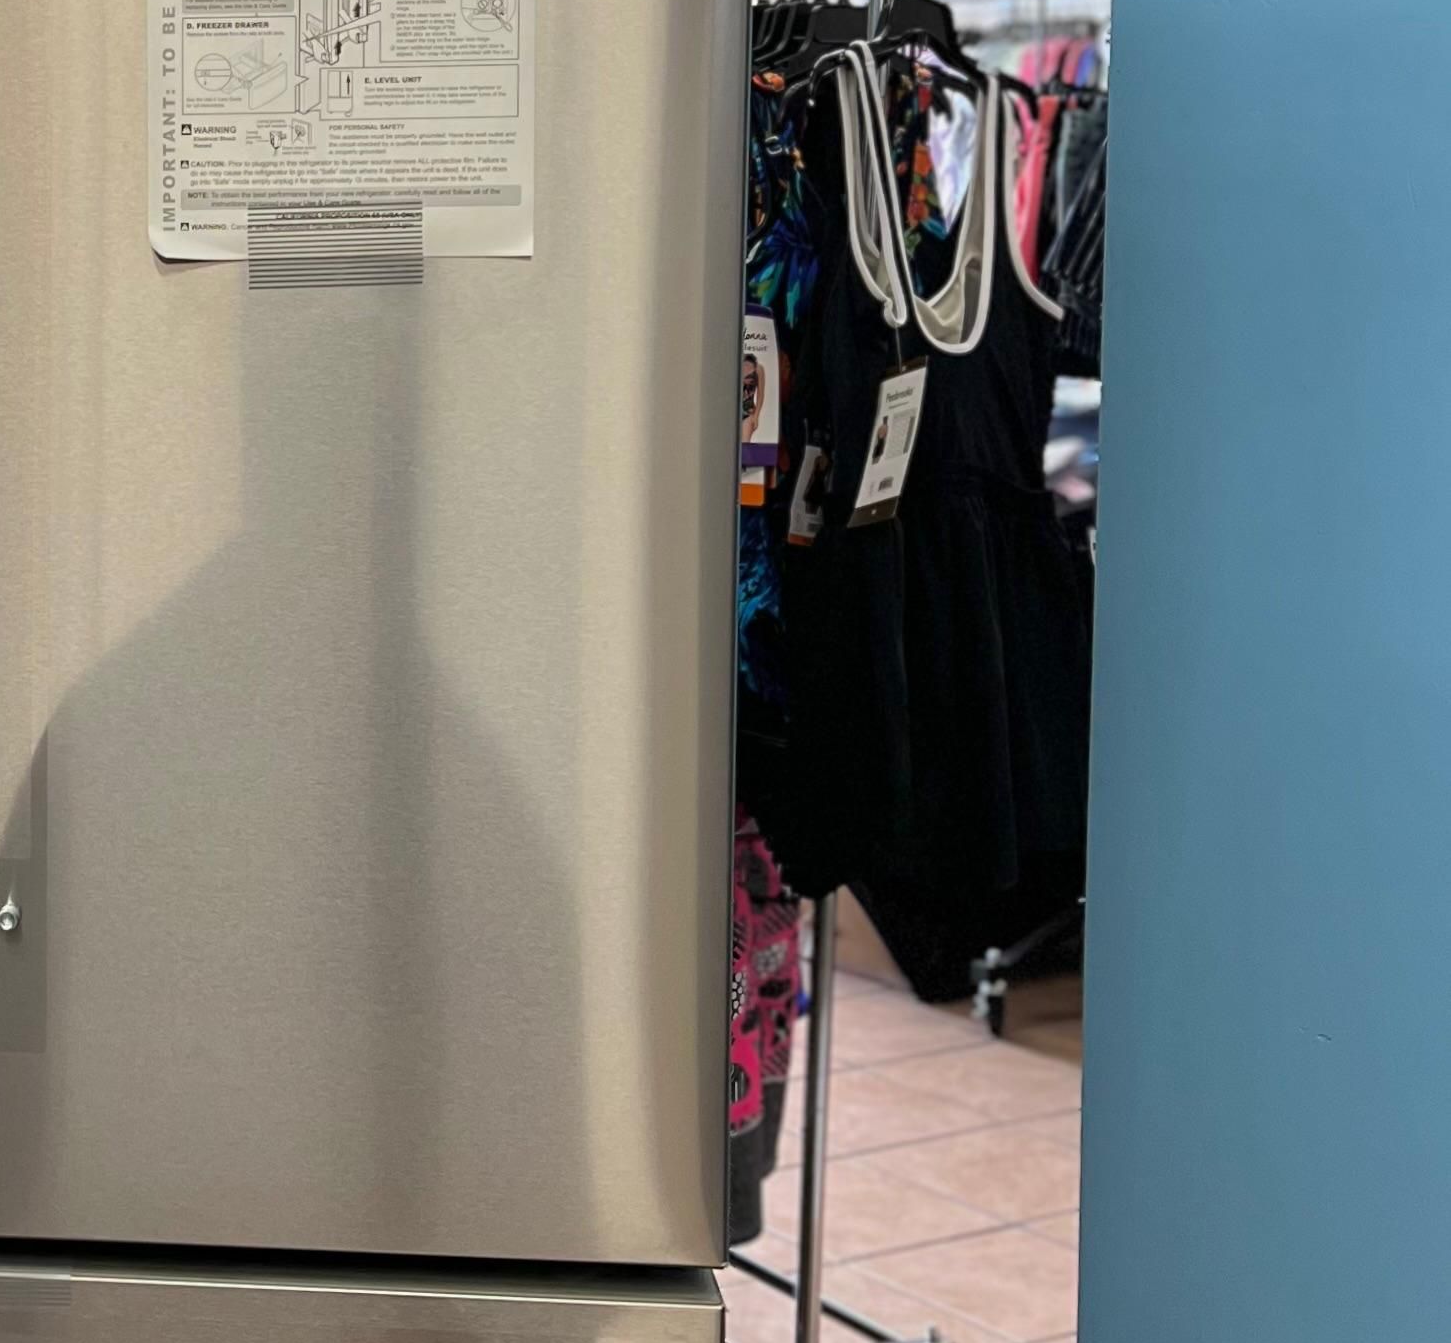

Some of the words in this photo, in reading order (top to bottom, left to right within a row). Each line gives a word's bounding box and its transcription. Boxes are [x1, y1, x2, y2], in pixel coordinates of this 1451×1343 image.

[162, 7, 176, 35] BE
[197, 22, 232, 30] FREEZER
[235, 21, 270, 29] DRAWER
[162, 48, 176, 77] TO
[374, 76, 400, 84] LEVEL
[194, 126, 237, 134] WARNING
[162, 89, 176, 232] IMPORTANT:
